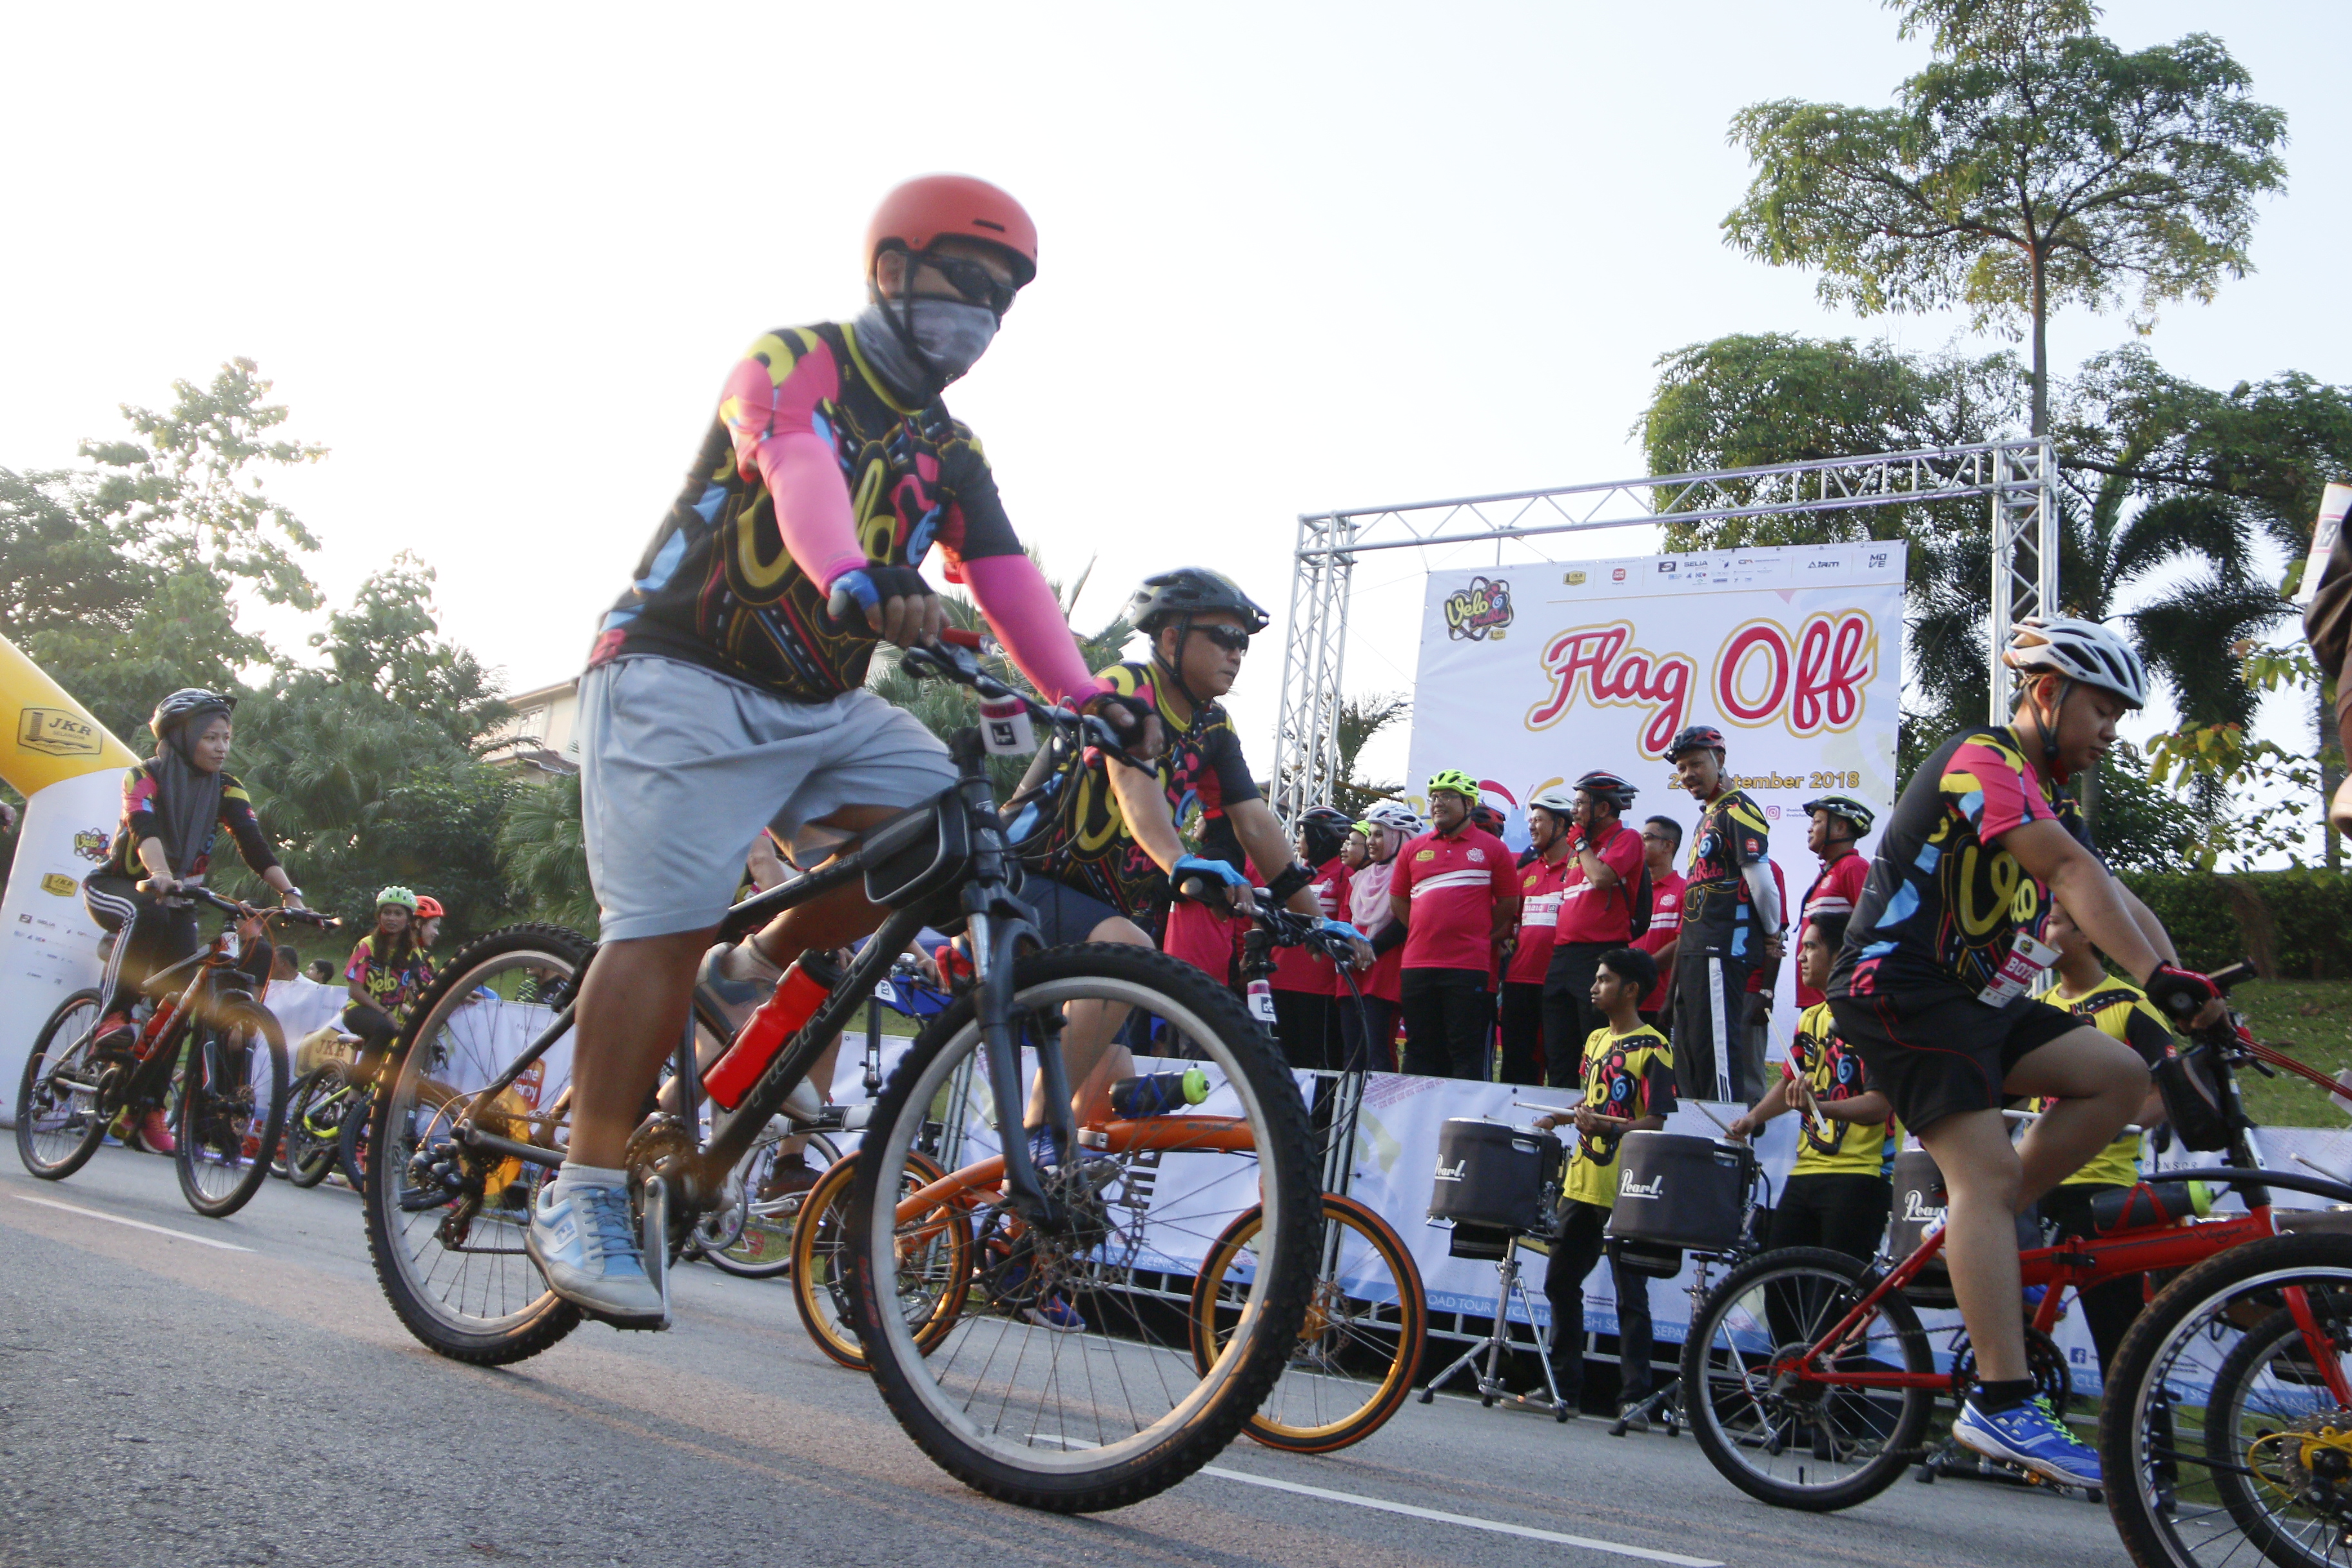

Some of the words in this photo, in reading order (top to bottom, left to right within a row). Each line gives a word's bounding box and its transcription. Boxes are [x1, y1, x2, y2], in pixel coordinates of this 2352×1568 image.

[1531, 625, 1692, 753] Flag
[1718, 615, 1871, 731] Off
[49, 718, 92, 736] JKR
[1730, 771, 1804, 789] tember
[1809, 771, 1859, 789] 2018
[2144, 1161, 2197, 1170] PONSOR
[1426, 1294, 1456, 1307] OAD
[1459, 1298, 1491, 1313] TOUR
